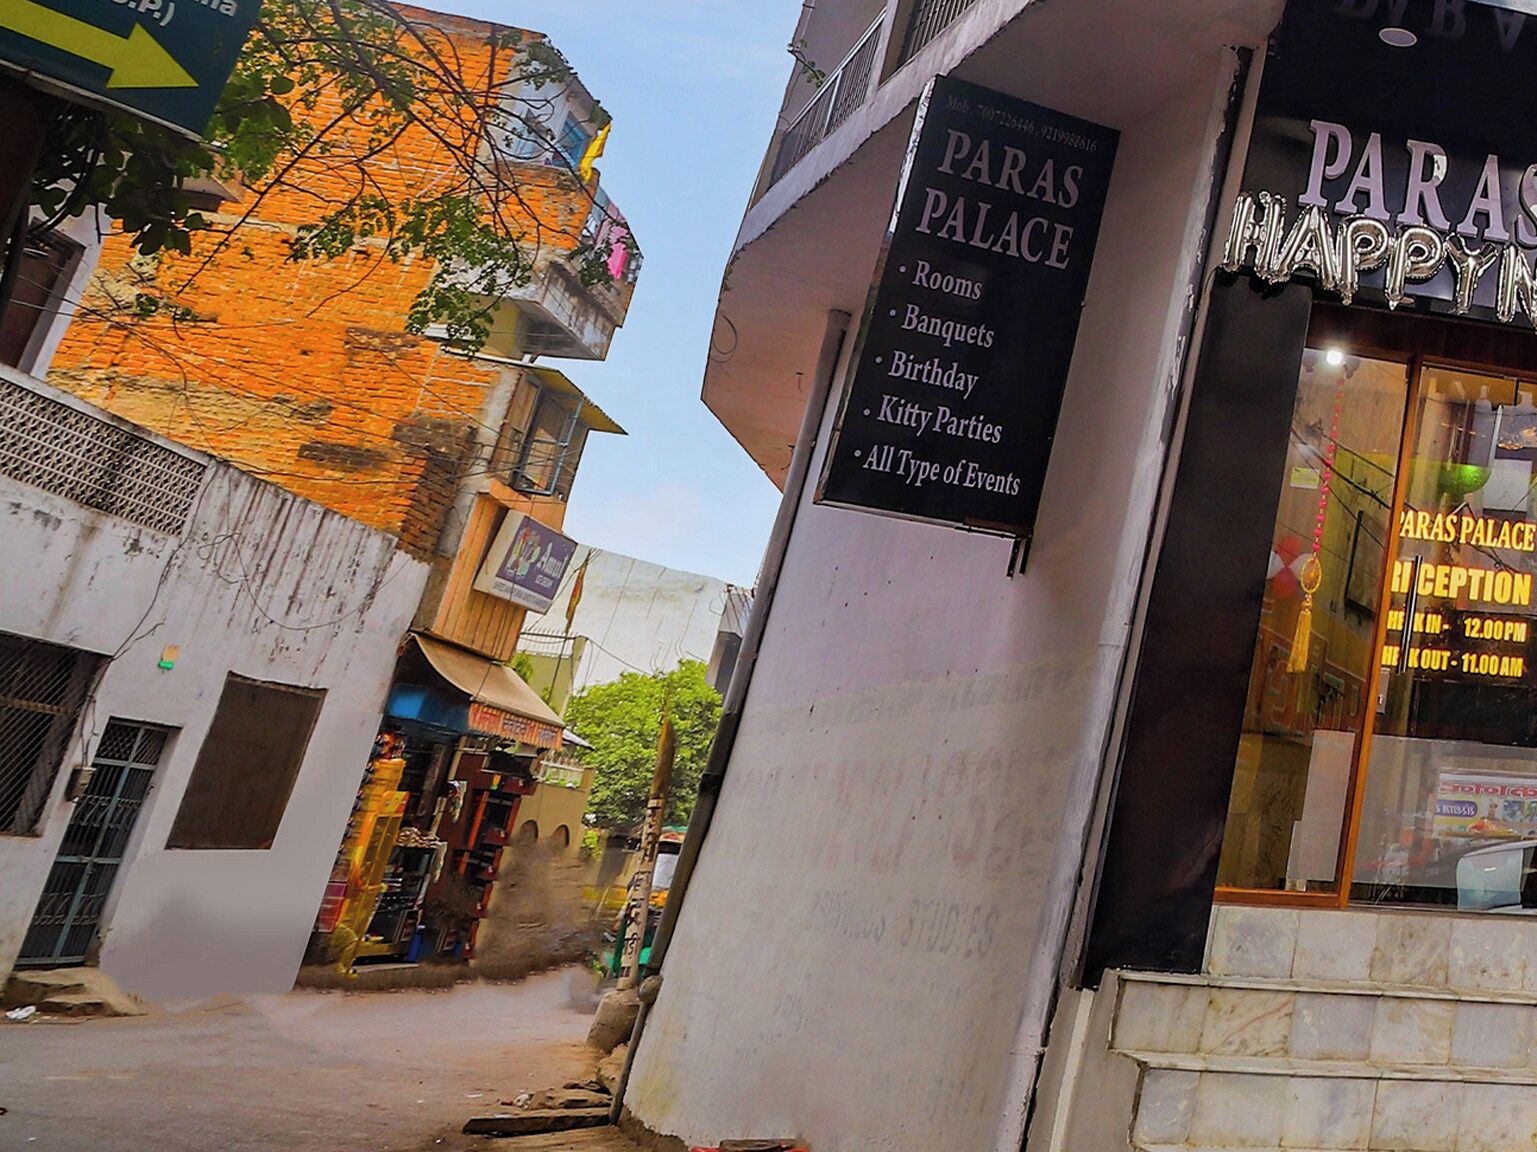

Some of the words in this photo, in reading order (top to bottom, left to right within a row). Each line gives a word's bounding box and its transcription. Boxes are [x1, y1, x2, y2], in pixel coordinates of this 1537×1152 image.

[937, 128, 1083, 210] PARAS
[916, 187, 1075, 271] PALACE
[1223, 190, 1500, 314] HAPPY
[912, 260, 982, 300] Rooms
[901, 304, 995, 349] Banquets
[888, 350, 979, 400] Birthday
[877, 394, 932, 437] Kitty
[933, 404, 1003, 445] Parties
[863, 444, 895, 474] All
[898, 448, 940, 486] Type
[943, 460, 967, 486] of
[964, 466, 1021, 497] Events
[1400, 511, 1458, 543] ARAS
[1459, 516, 1537, 552] PALACE
[1464, 617, 1504, 642] 12.00
[1504, 622, 1527, 643] PM
[1461, 652, 1500, 676] 11.00
[1500, 656, 1525, 678] AM
